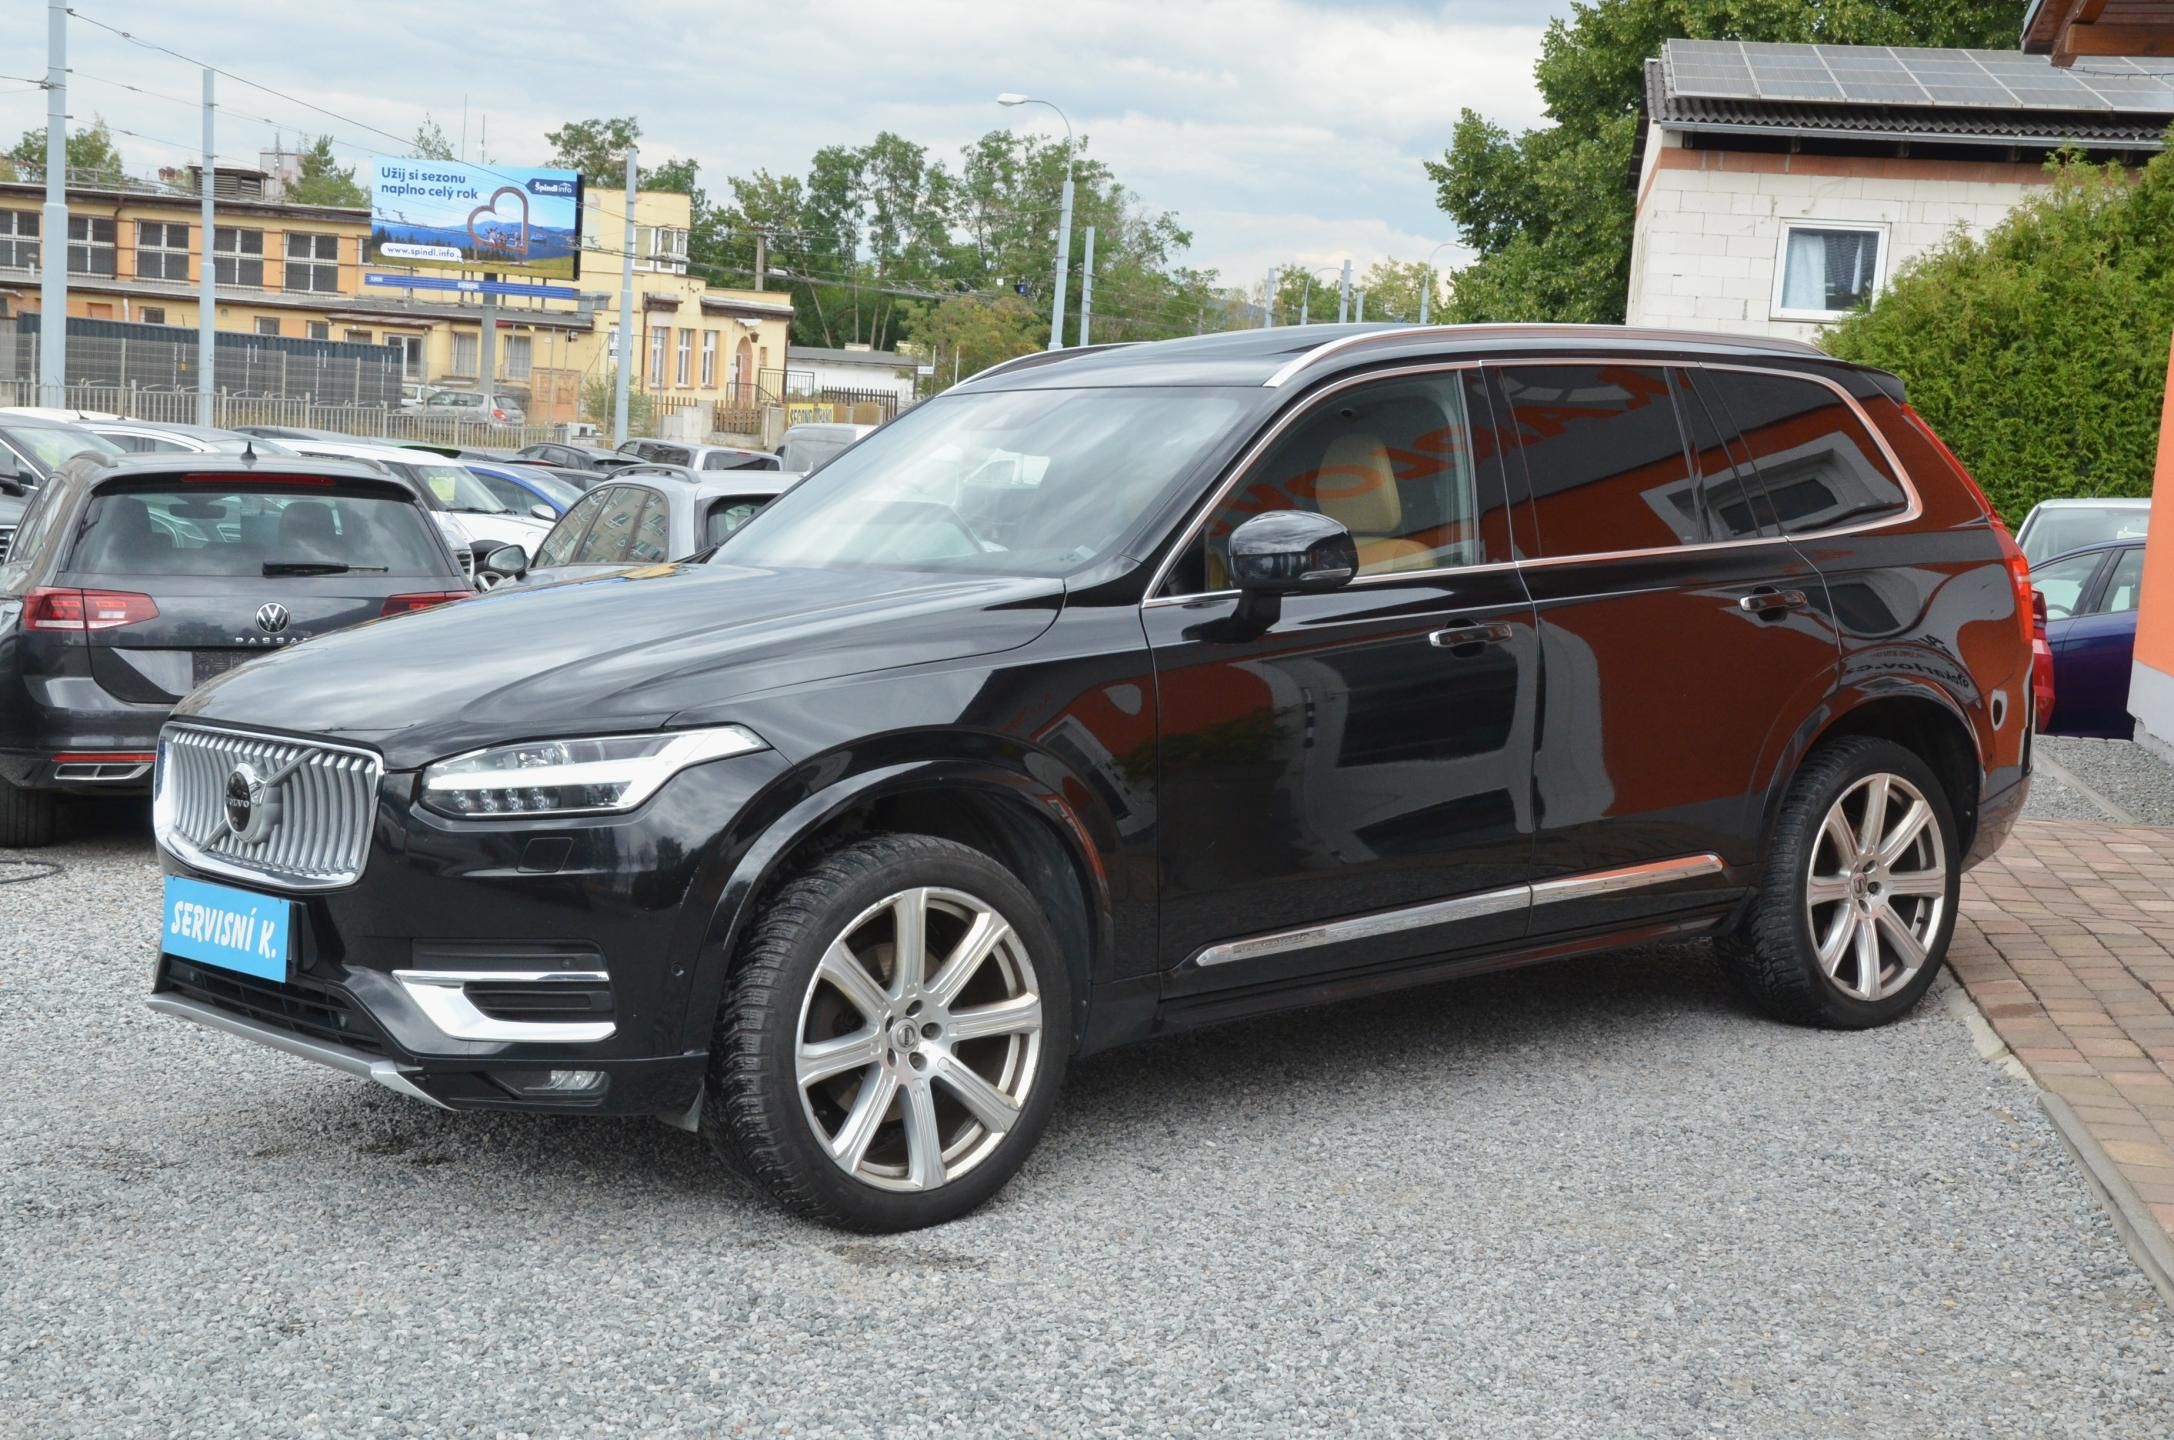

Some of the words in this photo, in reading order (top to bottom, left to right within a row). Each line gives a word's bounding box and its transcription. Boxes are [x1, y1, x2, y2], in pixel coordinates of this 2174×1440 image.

[381, 167, 406, 182] Užij
[408, 169, 418, 180] si
[421, 172, 466, 184] sezonu
[381, 183, 426, 197] naplno
[428, 185, 454, 200] celý
[456, 187, 478, 199] rok
[387, 247, 455, 258] www.spindl.info
[170, 900, 256, 952] SERVISNÍ
[258, 919, 277, 959] K.
